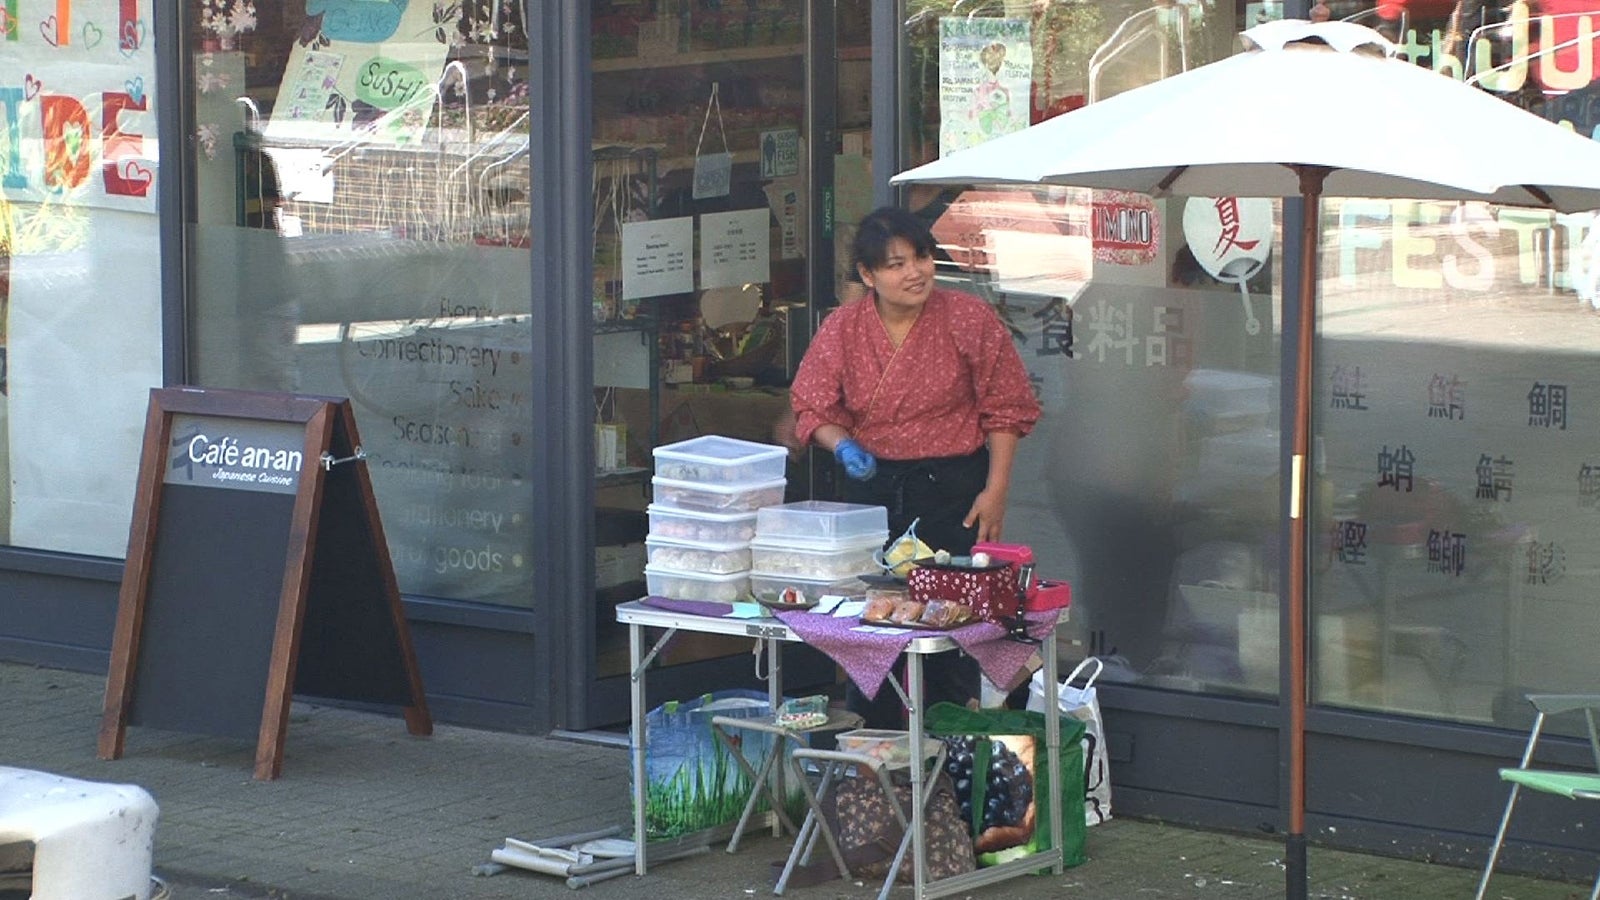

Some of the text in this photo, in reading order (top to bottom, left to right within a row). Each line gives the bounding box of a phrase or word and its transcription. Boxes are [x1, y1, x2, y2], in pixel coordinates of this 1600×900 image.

[1527, 382, 1567, 430] 鯛
[188, 434, 303, 472] Café an-an
[212, 467, 293, 486] Japanese Cuisine
[434, 545, 502, 574] goods
